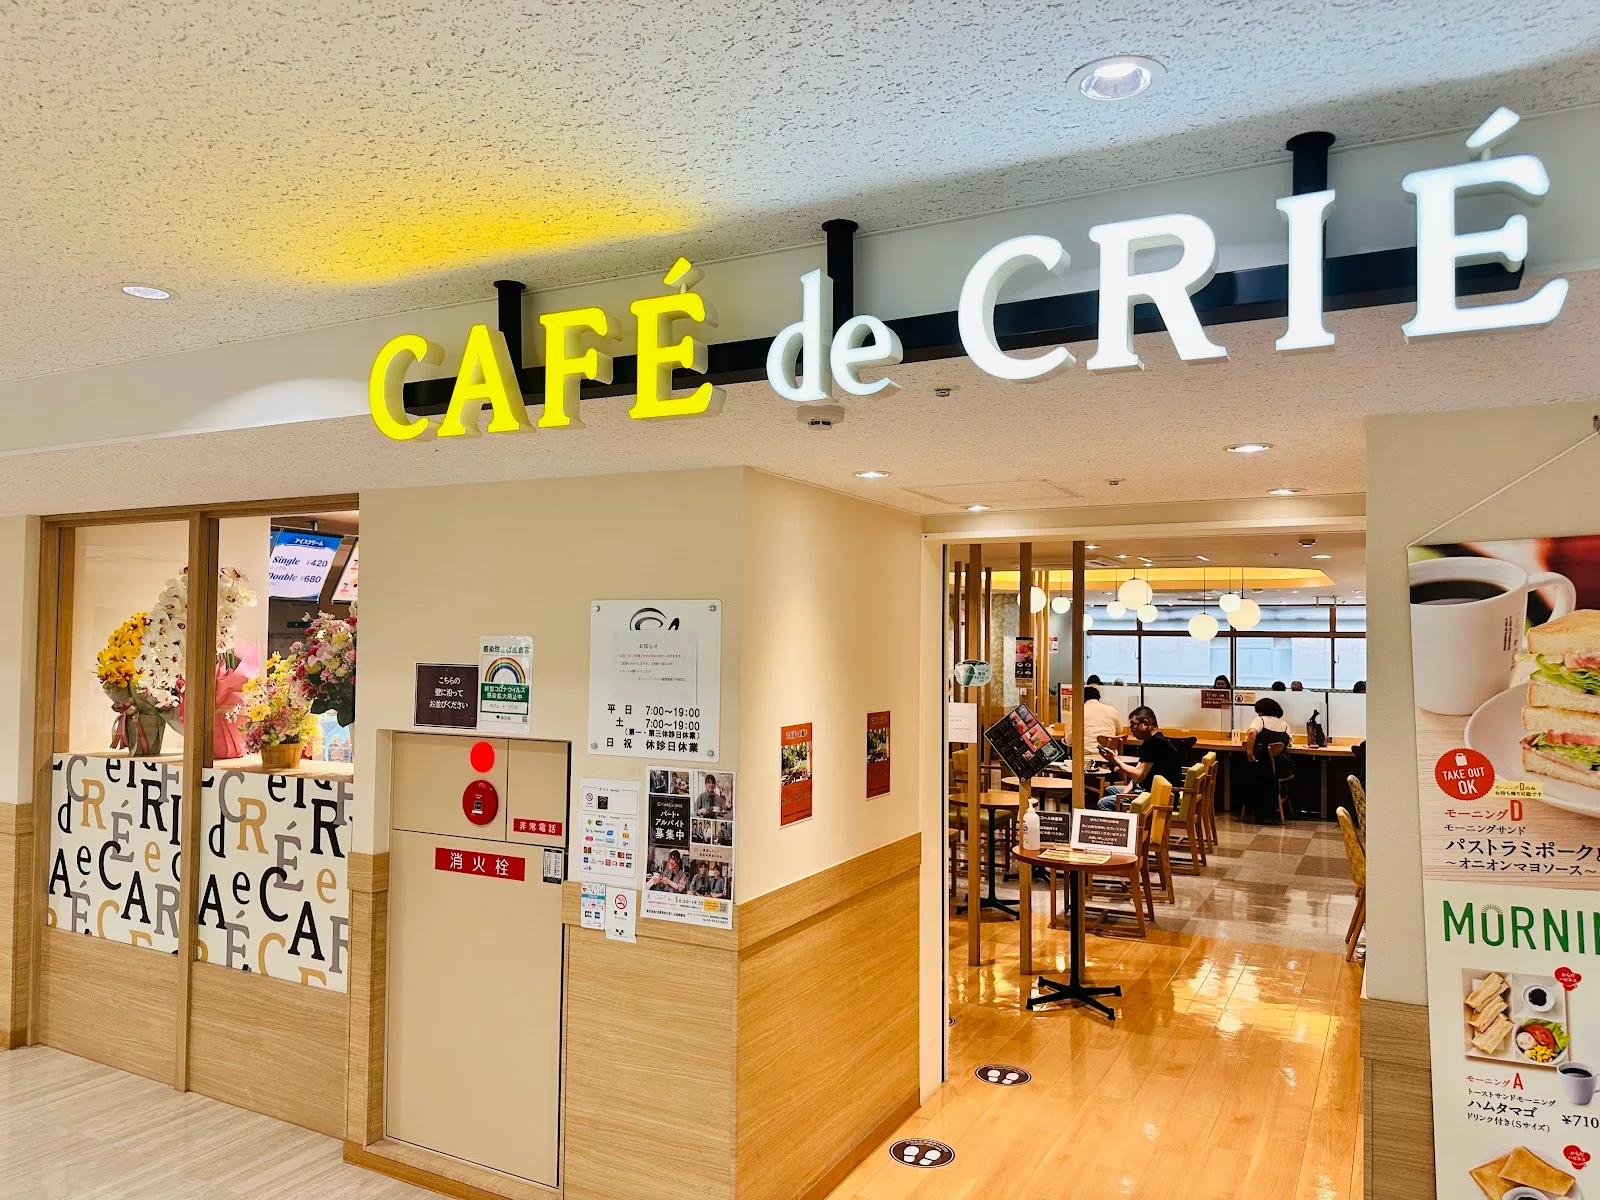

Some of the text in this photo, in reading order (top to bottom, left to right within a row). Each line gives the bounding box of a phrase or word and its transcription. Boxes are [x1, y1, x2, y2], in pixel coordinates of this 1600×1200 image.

[368, 107, 1569, 441] CAFÉ de CRIÉ
[294, 537, 324, 546] アイスクリーム
[272, 556, 300, 566] Single
[438, 676, 461, 685] こちらの
[434, 687, 463, 697] 壁に沿って
[484, 685, 526, 694] 新型コロナウイルス
[486, 692, 523, 700] 感染拡大防止中
[429, 700, 469, 709] お並びください
[615, 717, 624, 727] 土
[645, 739, 699, 753] 休診日休業
[1442, 767, 1485, 782] TAKE OUT
[1458, 779, 1478, 795] OK
[1445, 799, 1523, 822] モーニングD
[519, 821, 556, 834] 非常電話
[655, 818, 684, 828] アルバイト
[654, 827, 685, 841] 募集中
[1444, 824, 1526, 836] モーニングサンド
[449, 852, 510, 876] 消火栓
[1466, 1072, 1524, 1091] モーニングA
[1468, 1088, 1556, 1107] トーストサンドモーニング
[1467, 1100, 1538, 1118] ハムタマゴ
[1562, 1114, 1600, 1129] ¥710
